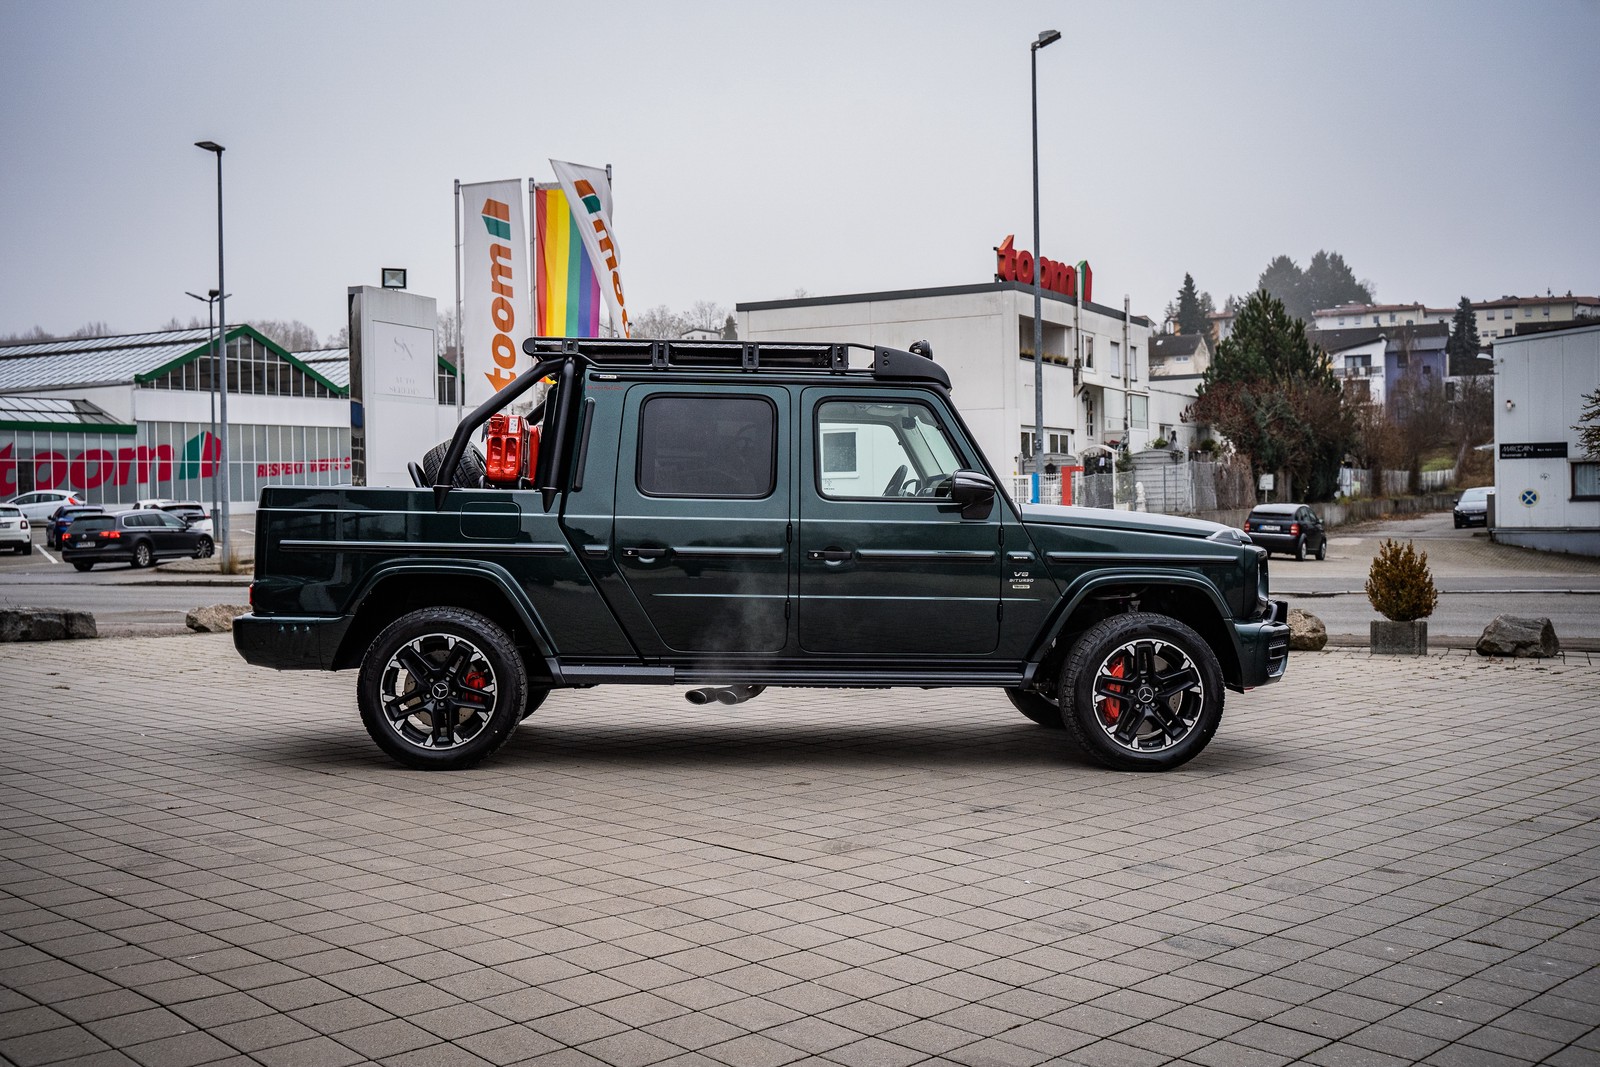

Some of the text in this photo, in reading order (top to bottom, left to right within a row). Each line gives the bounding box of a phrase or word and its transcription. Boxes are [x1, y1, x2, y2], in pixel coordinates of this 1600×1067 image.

[997, 234, 1075, 297] toom
[485, 243, 516, 392] toom
[0, 443, 175, 496] toom
